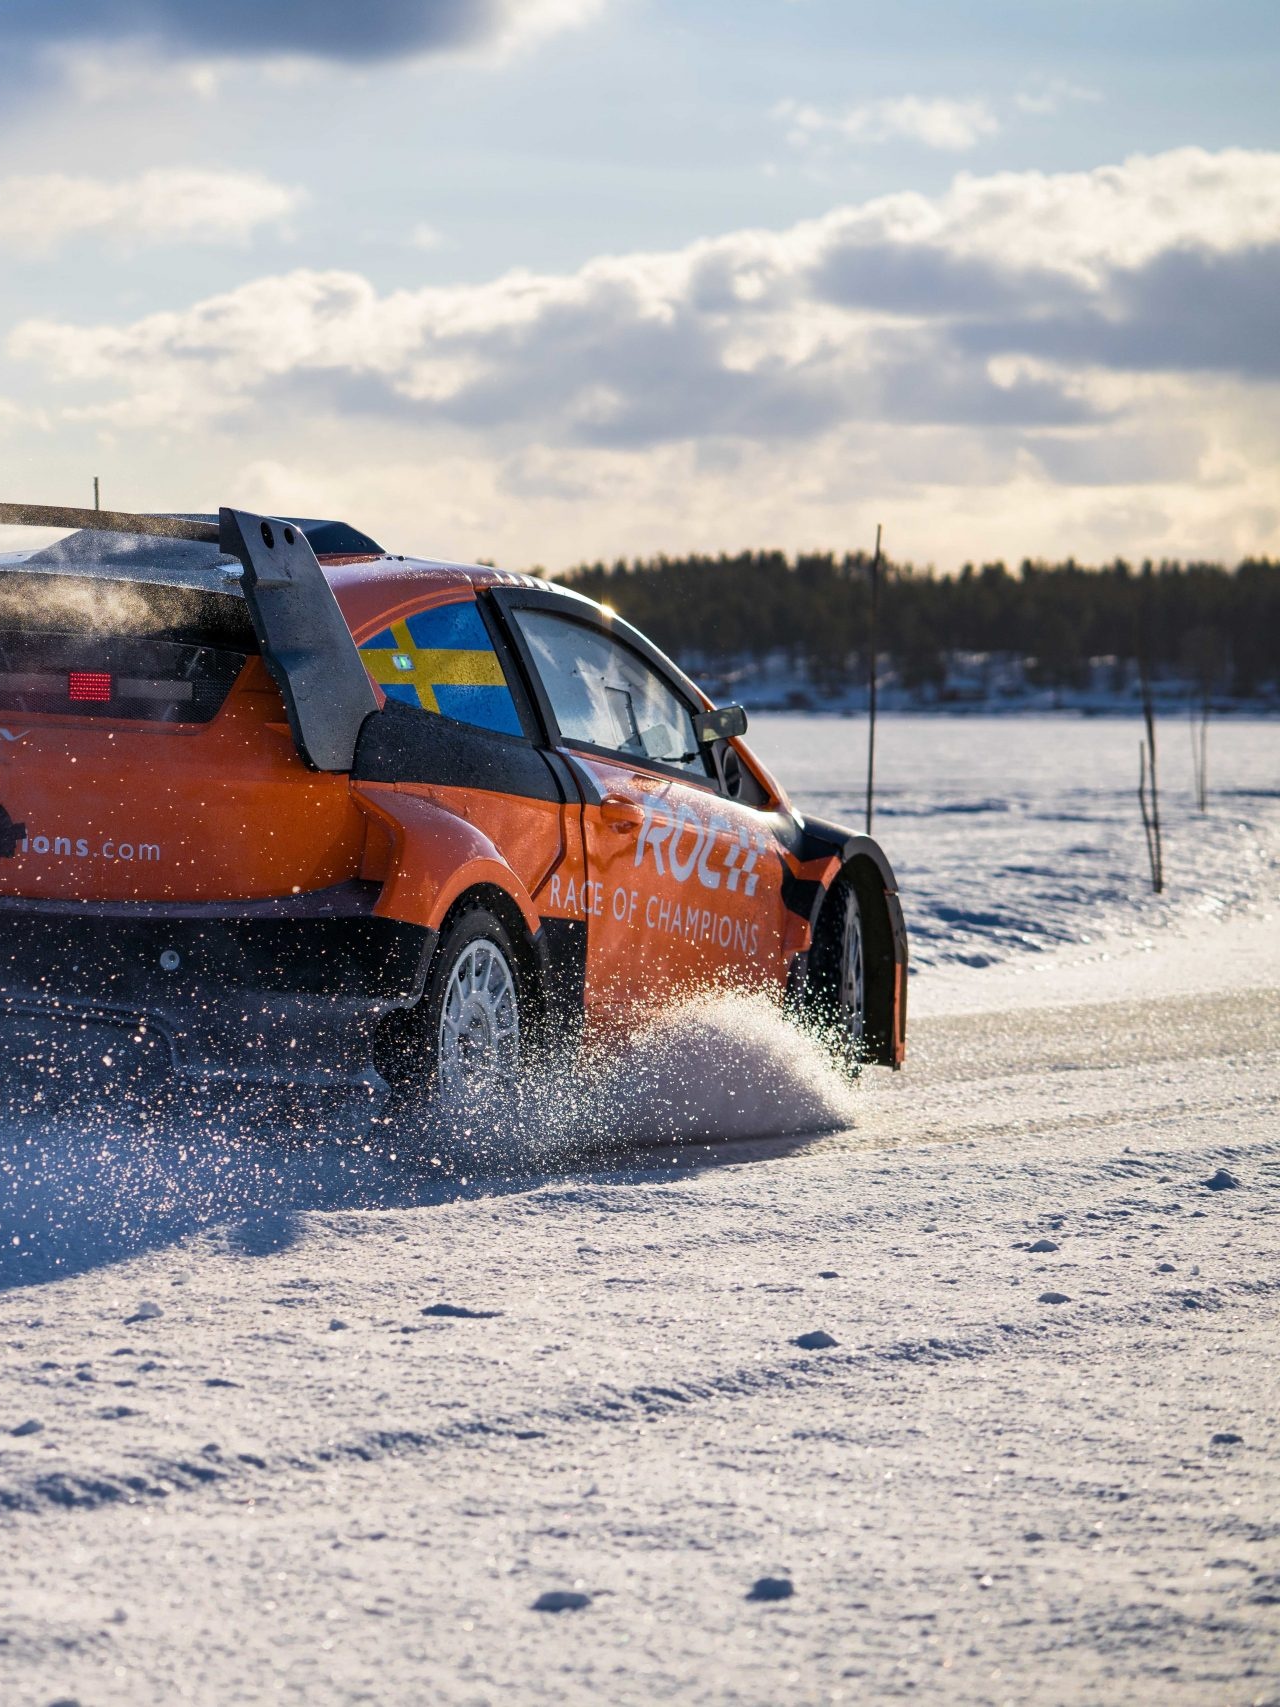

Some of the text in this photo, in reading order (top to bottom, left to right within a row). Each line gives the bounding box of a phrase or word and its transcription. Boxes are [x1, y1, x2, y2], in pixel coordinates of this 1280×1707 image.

[550, 873, 760, 954] RACE OF CHAMPIONS
